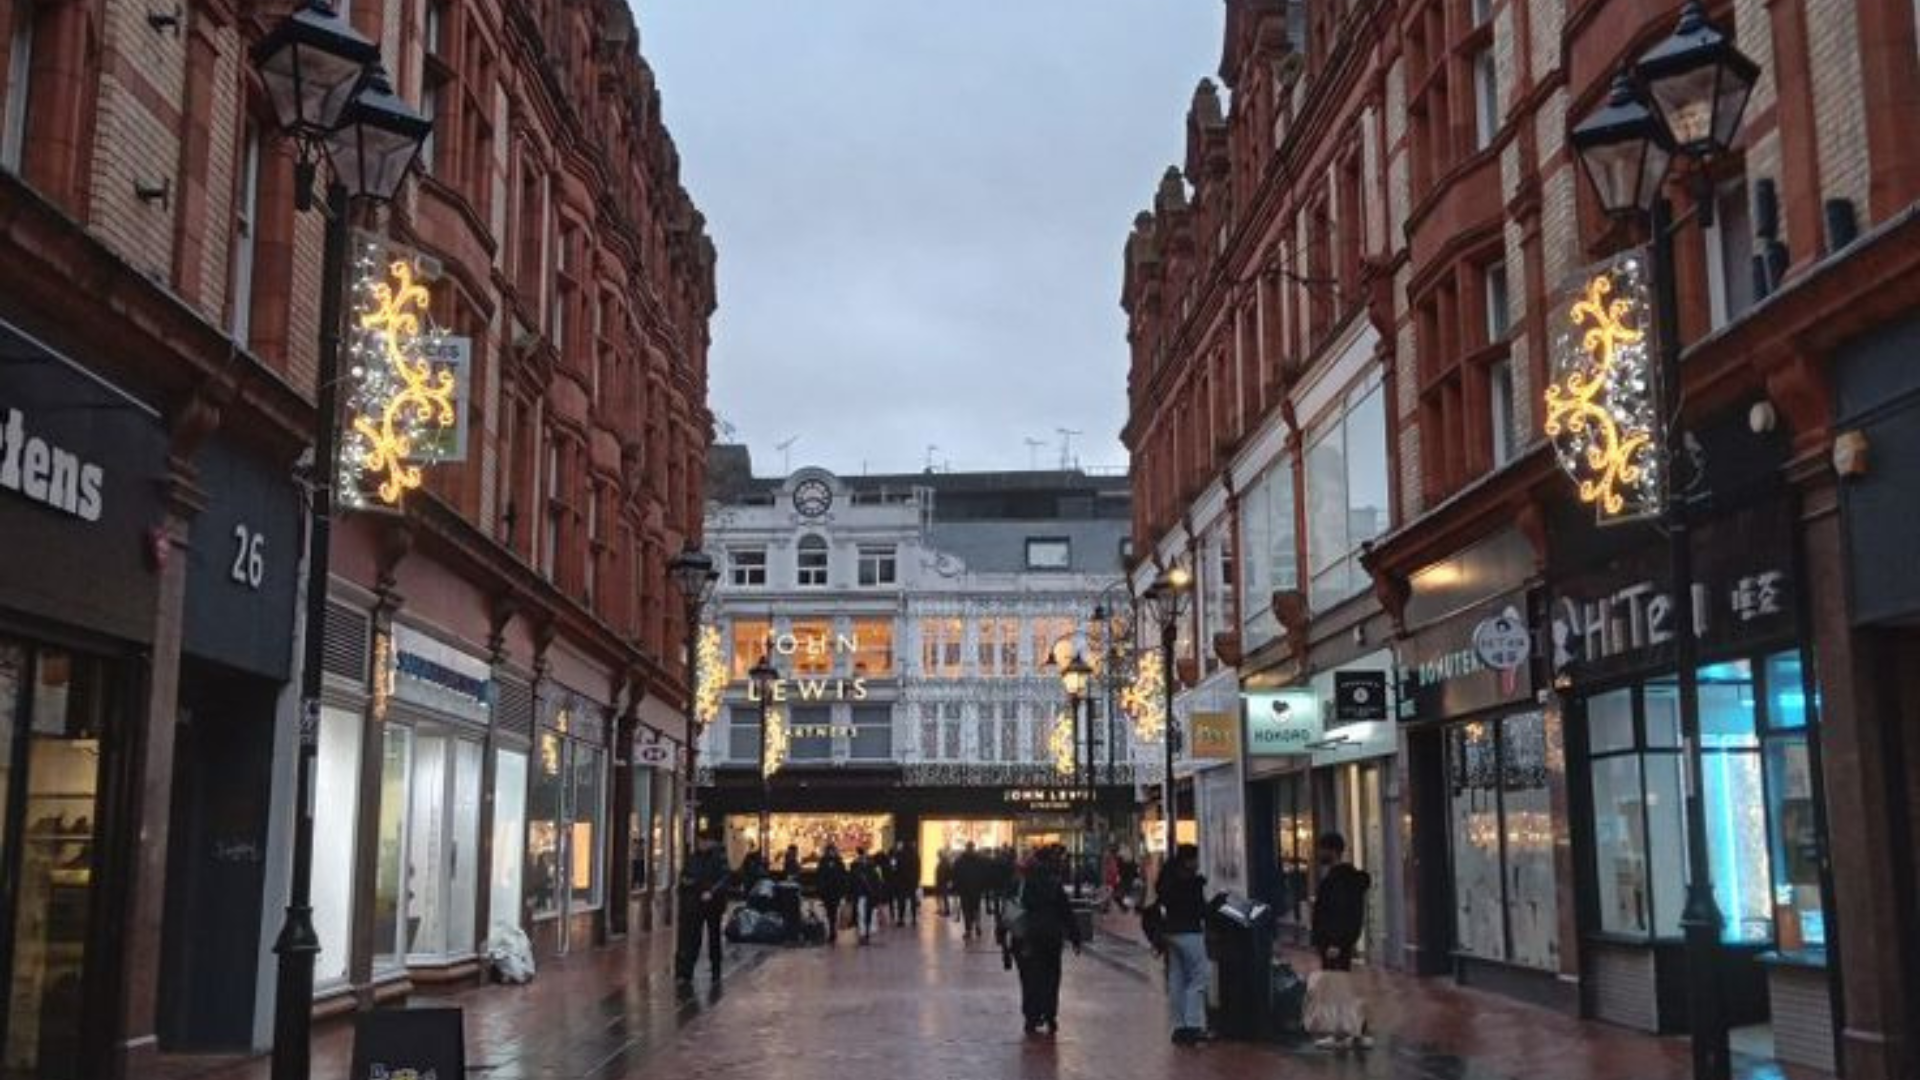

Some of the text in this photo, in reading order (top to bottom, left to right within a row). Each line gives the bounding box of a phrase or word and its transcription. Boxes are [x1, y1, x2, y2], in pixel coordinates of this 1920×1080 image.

[0, 407, 104, 522] tens
[232, 525, 266, 588] 26
[1585, 581, 1709, 662] HiTe
[748, 677, 868, 701] LEWIS
